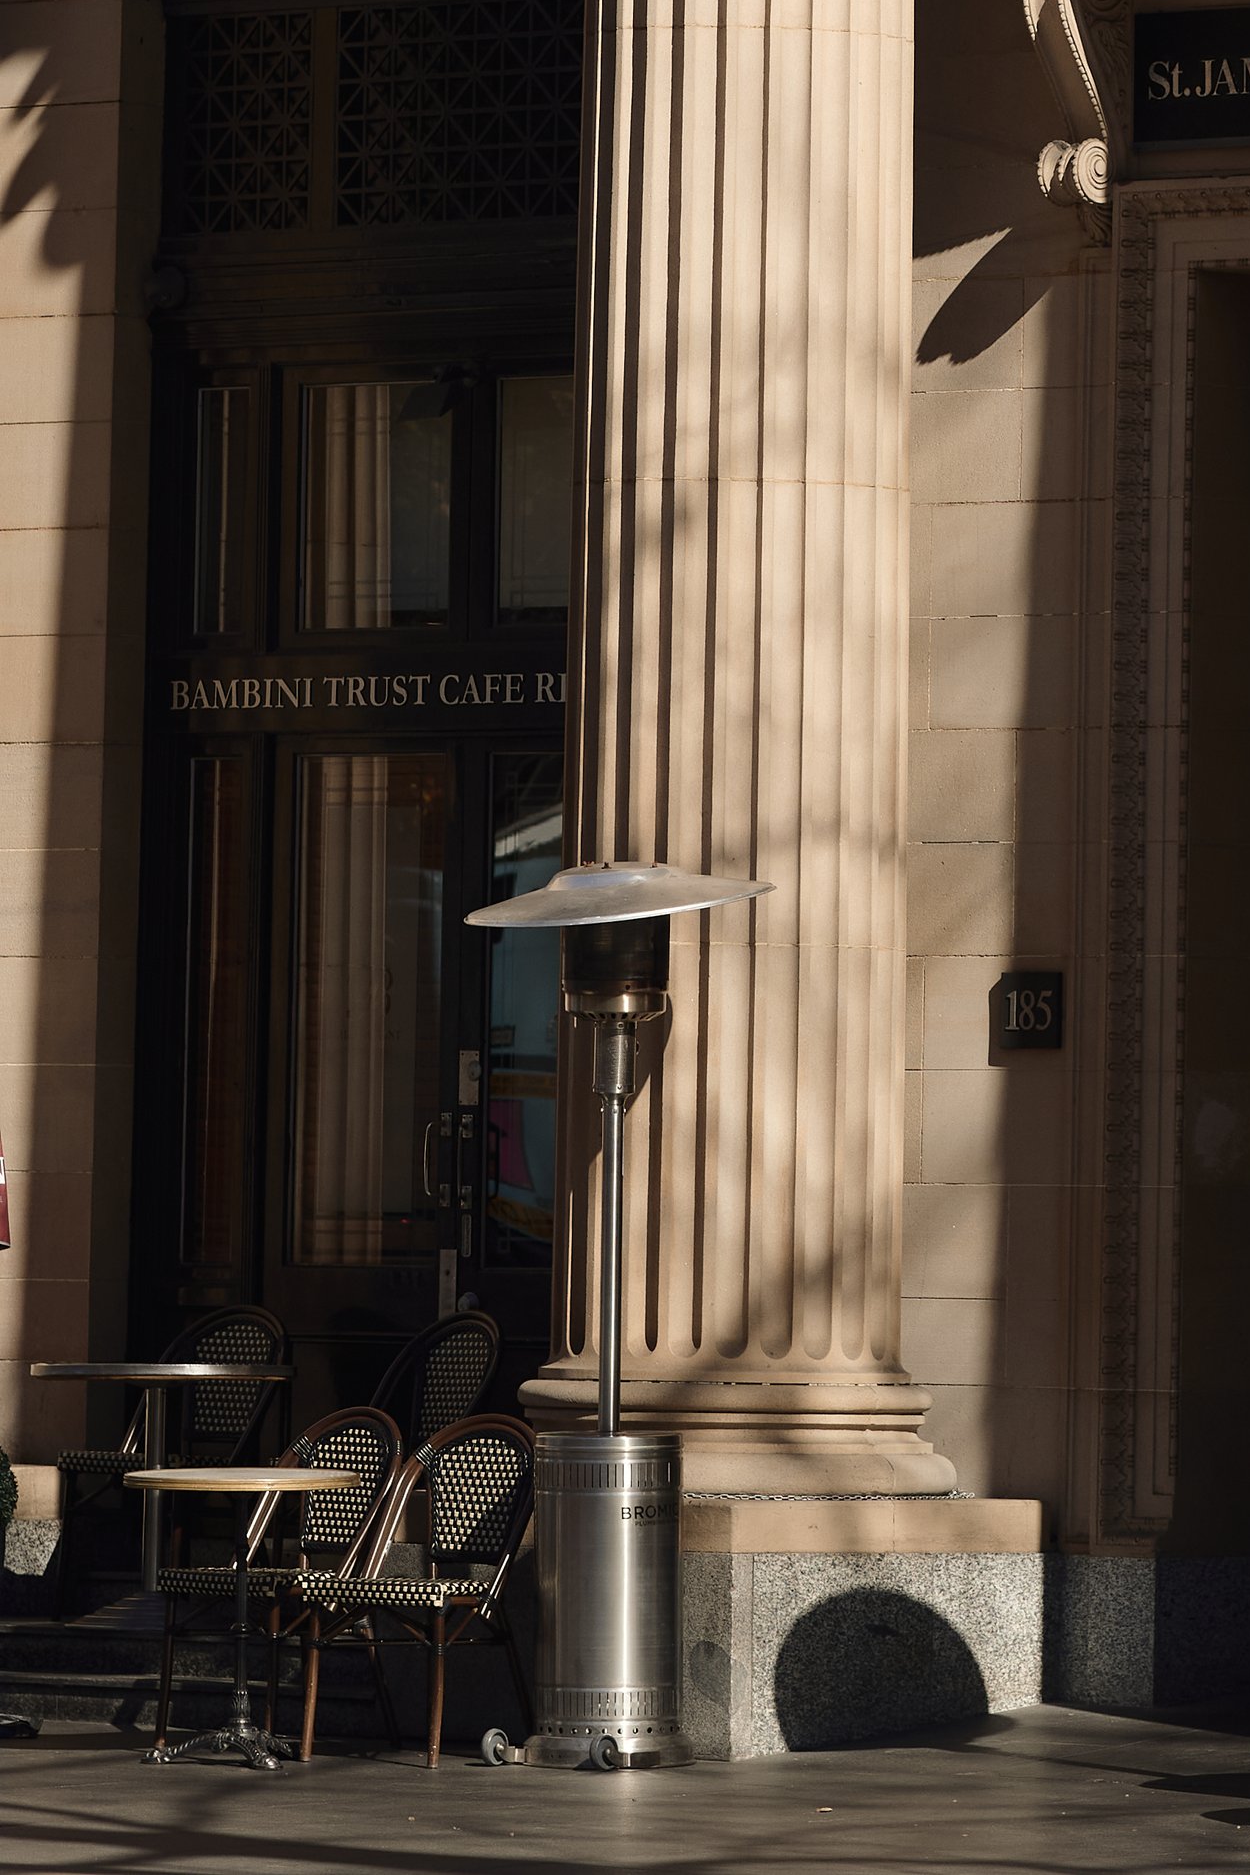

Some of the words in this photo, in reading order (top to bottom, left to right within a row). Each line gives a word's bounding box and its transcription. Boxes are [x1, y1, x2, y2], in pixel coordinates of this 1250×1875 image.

[170, 677, 314, 710] BAMBINI
[323, 674, 431, 707] TRUST
[439, 672, 525, 705] CAFE
[1004, 990, 1053, 1031] 185
